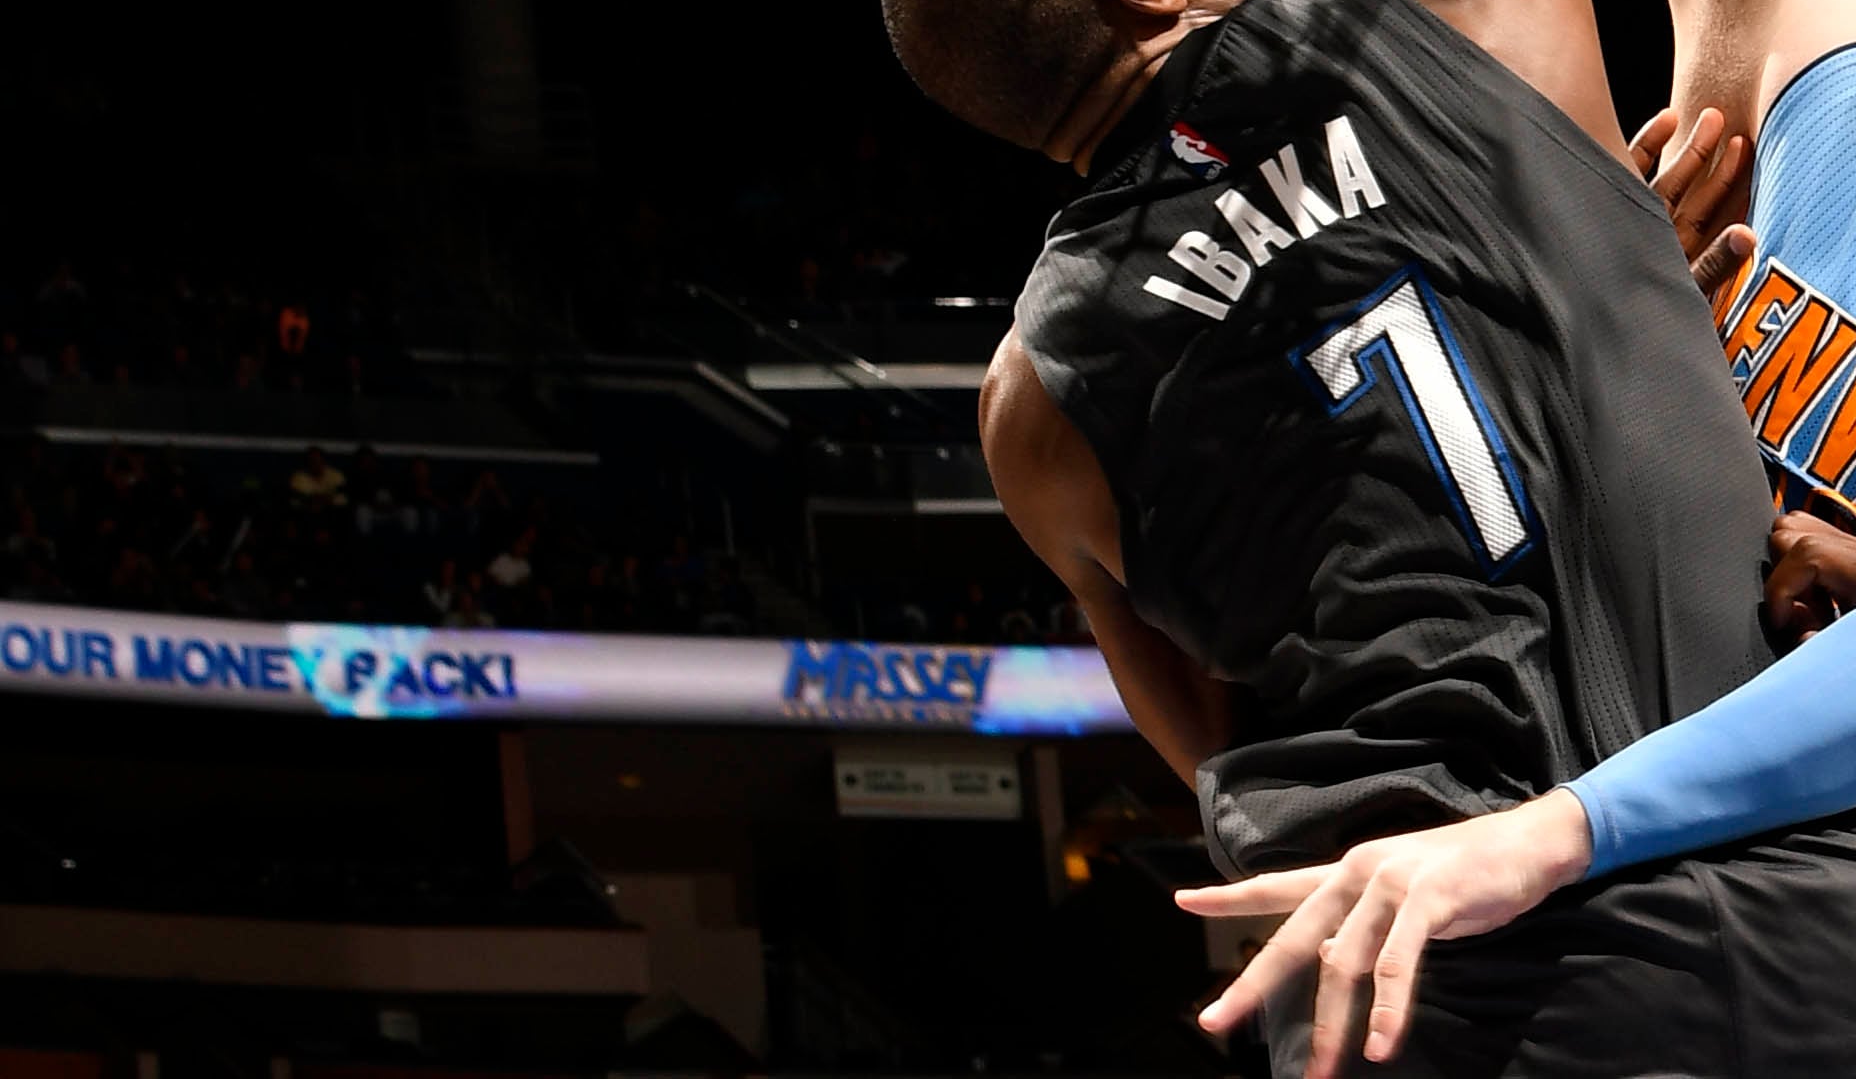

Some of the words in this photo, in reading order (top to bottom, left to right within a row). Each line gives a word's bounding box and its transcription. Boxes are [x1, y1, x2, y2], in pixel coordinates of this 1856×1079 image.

[1143, 115, 1386, 320] IBAKA
[1289, 263, 1538, 581] 7
[1, 623, 118, 678] OUR
[784, 639, 993, 705] MASSEY
